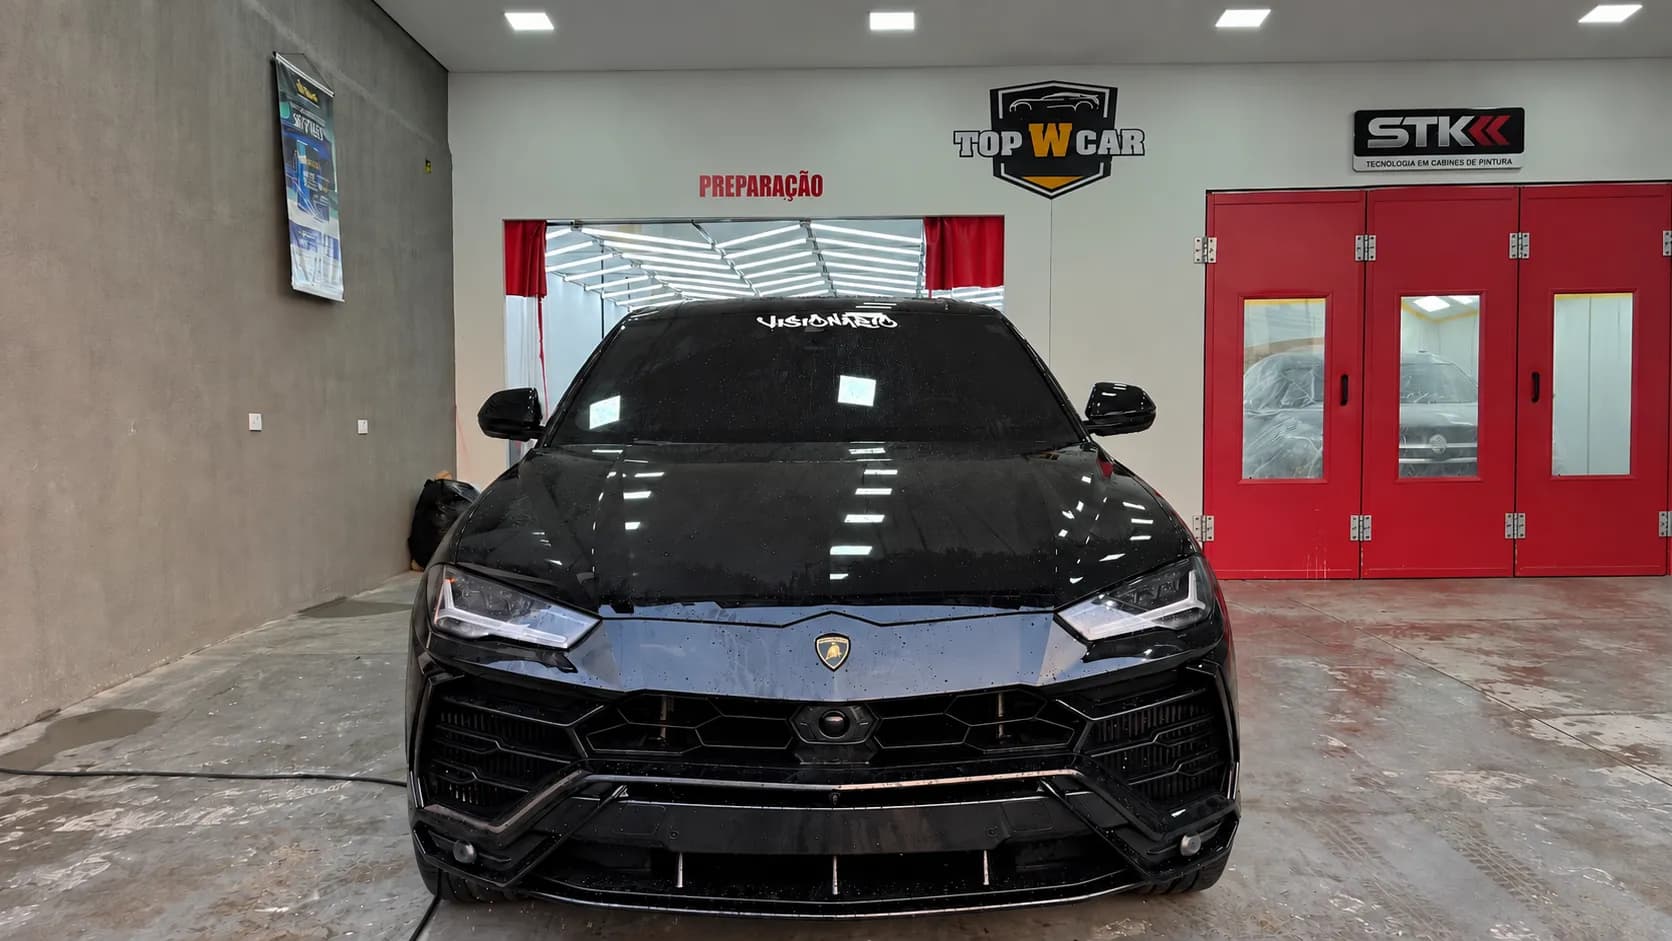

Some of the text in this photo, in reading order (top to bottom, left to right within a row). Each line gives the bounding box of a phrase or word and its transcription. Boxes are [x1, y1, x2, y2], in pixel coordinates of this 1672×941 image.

[954, 122, 1146, 158] TOP W CAR
[1367, 115, 1475, 148] STK
[1366, 157, 1513, 168] TECNOLOGIA EM CABINES DE PINTURA
[699, 170, 824, 202] PREPARAÇÃO
